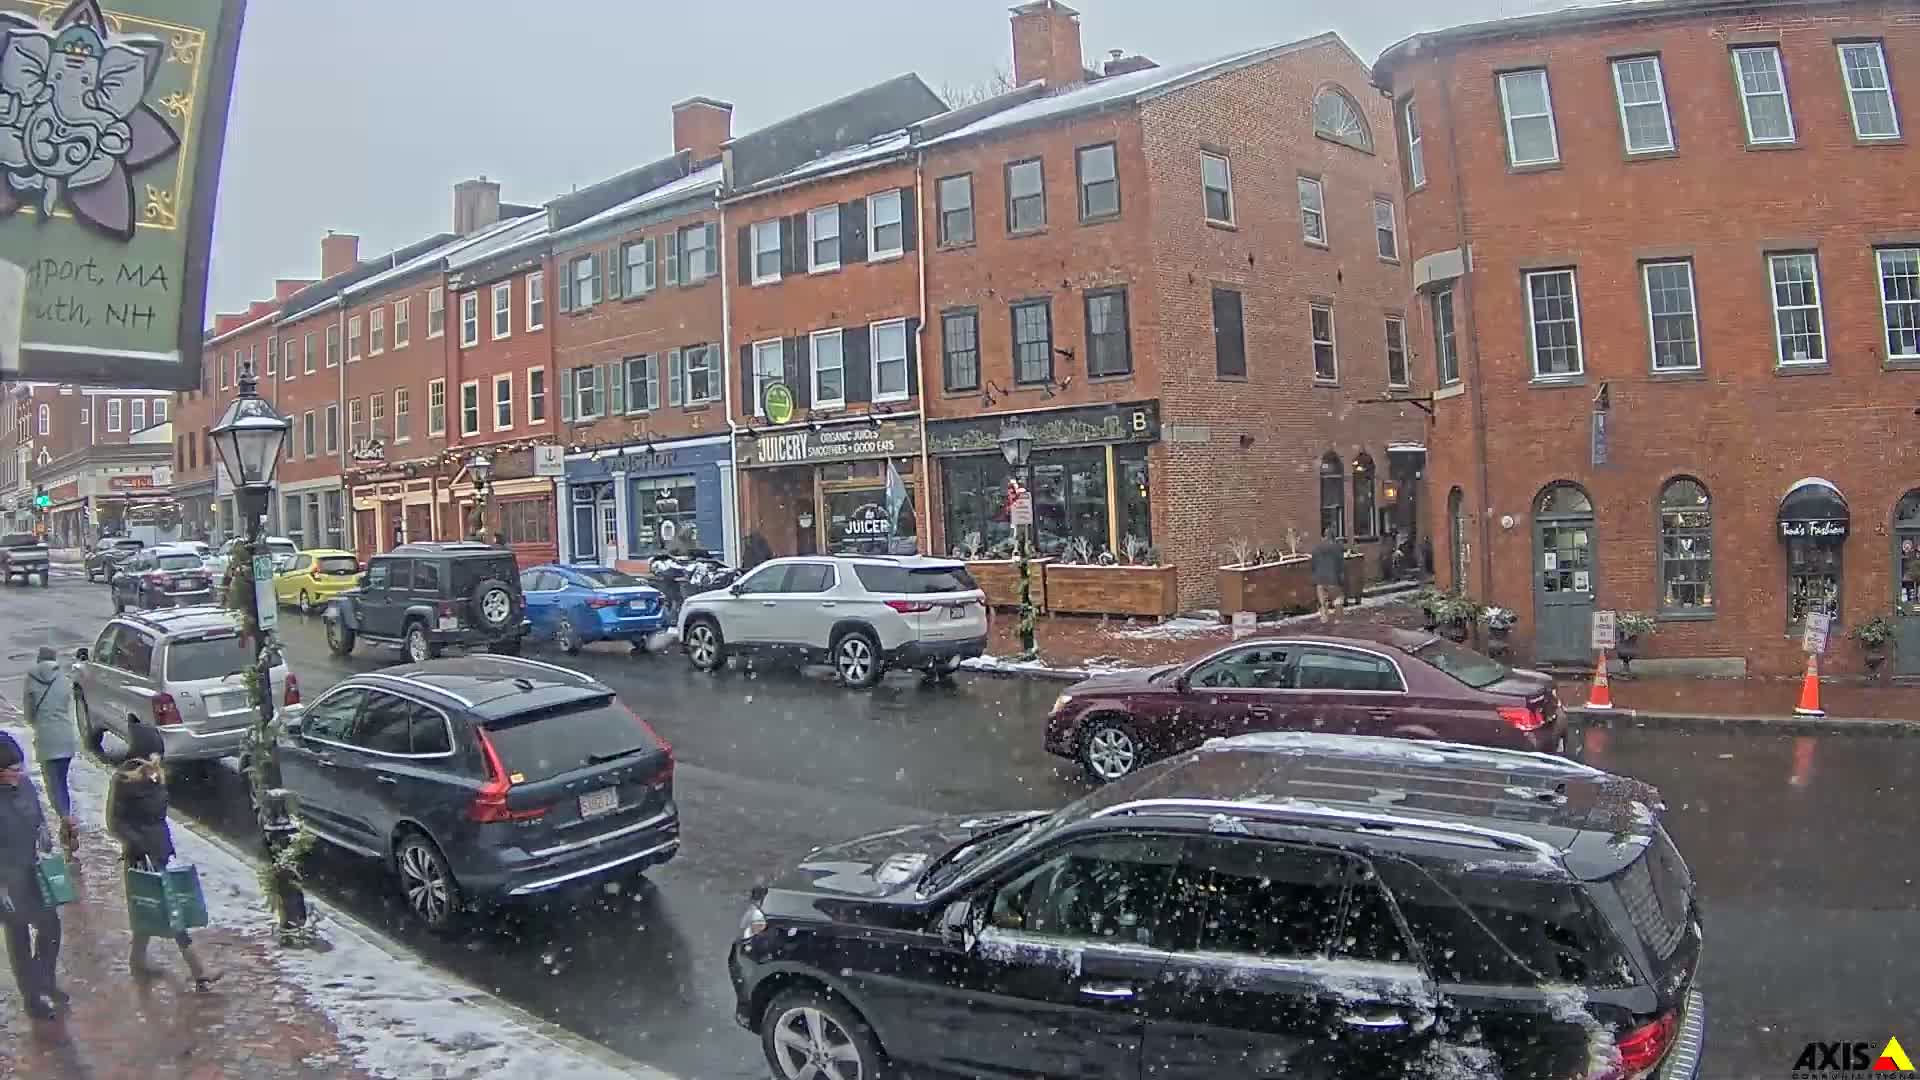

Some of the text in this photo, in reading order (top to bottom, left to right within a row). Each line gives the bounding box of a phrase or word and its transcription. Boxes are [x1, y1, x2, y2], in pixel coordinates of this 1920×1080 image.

[116, 263, 168, 291] MA
[105, 303, 156, 333] NH
[1131, 411, 1146, 431] B
[758, 433, 808, 462] JUICERY
[820, 430, 854, 444] ORGANIC
[807, 439, 896, 458] SMOOTHIES GOOD EATS
